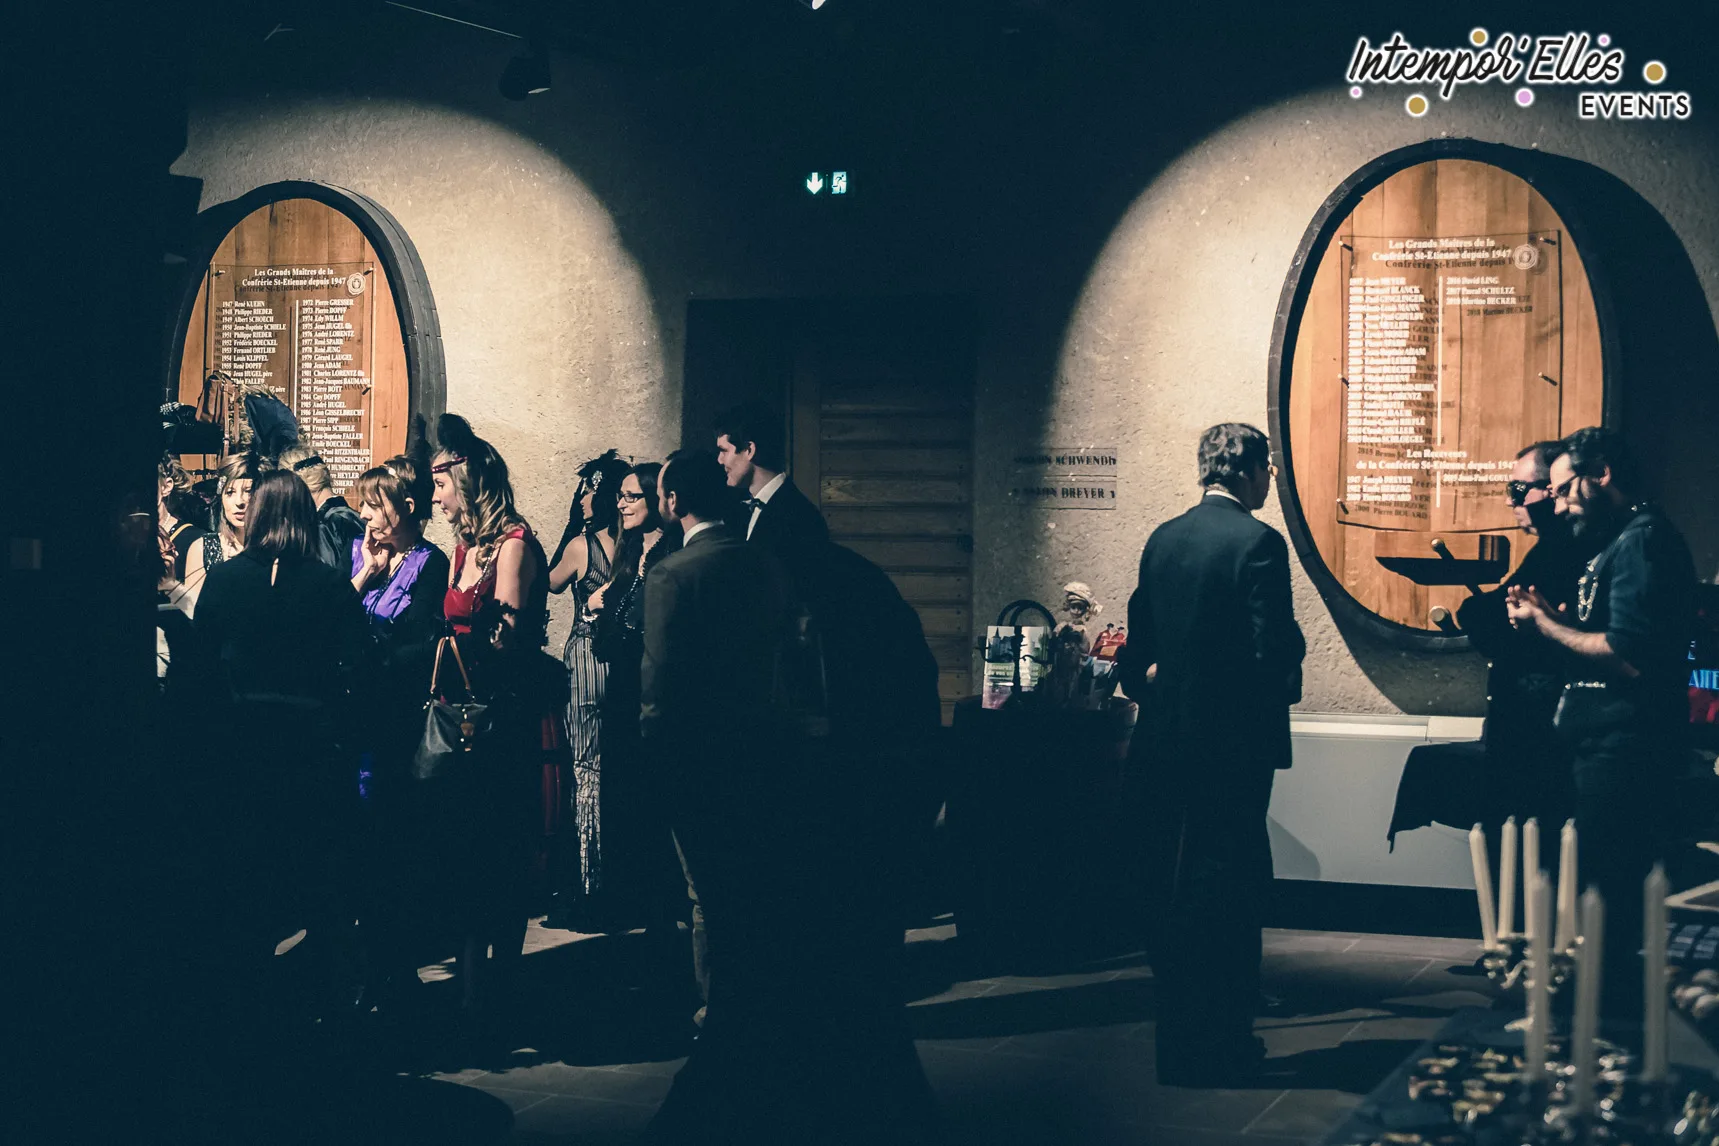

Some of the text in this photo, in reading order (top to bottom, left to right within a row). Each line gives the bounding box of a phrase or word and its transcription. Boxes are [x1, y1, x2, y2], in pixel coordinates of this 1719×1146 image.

[1405, 239, 1437, 248] Grands
[1474, 239, 1485, 248] de
[1486, 239, 1495, 248] la
[1461, 250, 1490, 260] depuis
[1491, 250, 1512, 260] 1947
[254, 268, 265, 276] Les
[267, 268, 291, 276] Grands
[318, 268, 327, 276] de
[327, 268, 334, 276] la
[242, 278, 347, 286] Confrérie St-Etienne depuis 1947
[1356, 460, 1367, 470] de
[1368, 460, 1377, 470] la
[1467, 460, 1496, 471] depuis
[1061, 488, 1105, 499] DREYER
